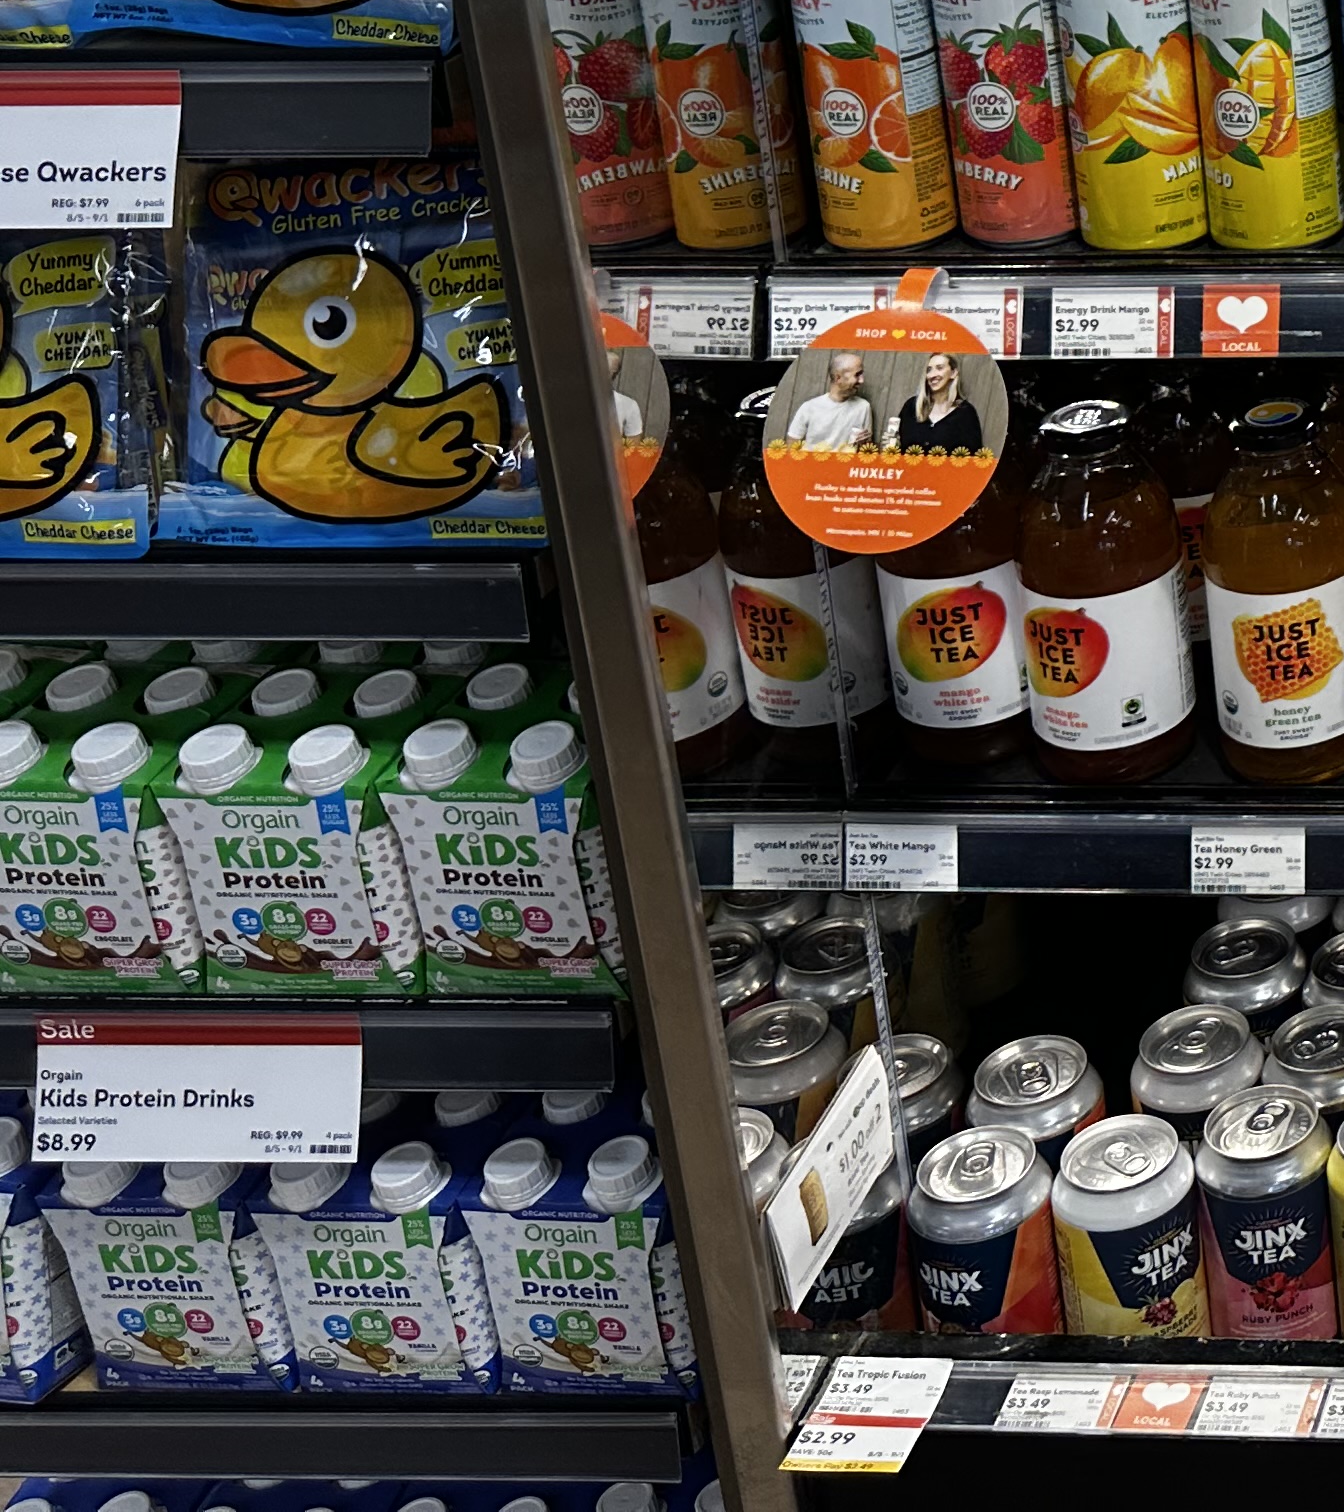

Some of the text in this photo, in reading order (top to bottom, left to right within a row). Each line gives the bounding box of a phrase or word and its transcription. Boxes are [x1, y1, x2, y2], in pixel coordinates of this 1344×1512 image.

[855, 328, 948, 342] SHOP LOCAL
[849, 467, 904, 480] HUXLEY
[1193, 844, 1283, 856] Tea Honey Green
[1194, 856, 1234, 870] $2.99
[224, 870, 325, 888] Protein
[40, 1069, 83, 1083] Orgain
[40, 1088, 255, 1109] Kids Protein Drinks
[37, 1132, 97, 1153] $8.99
[1234, 1222, 1308, 1249] JINX
[1248, 1245, 1296, 1265] TEA
